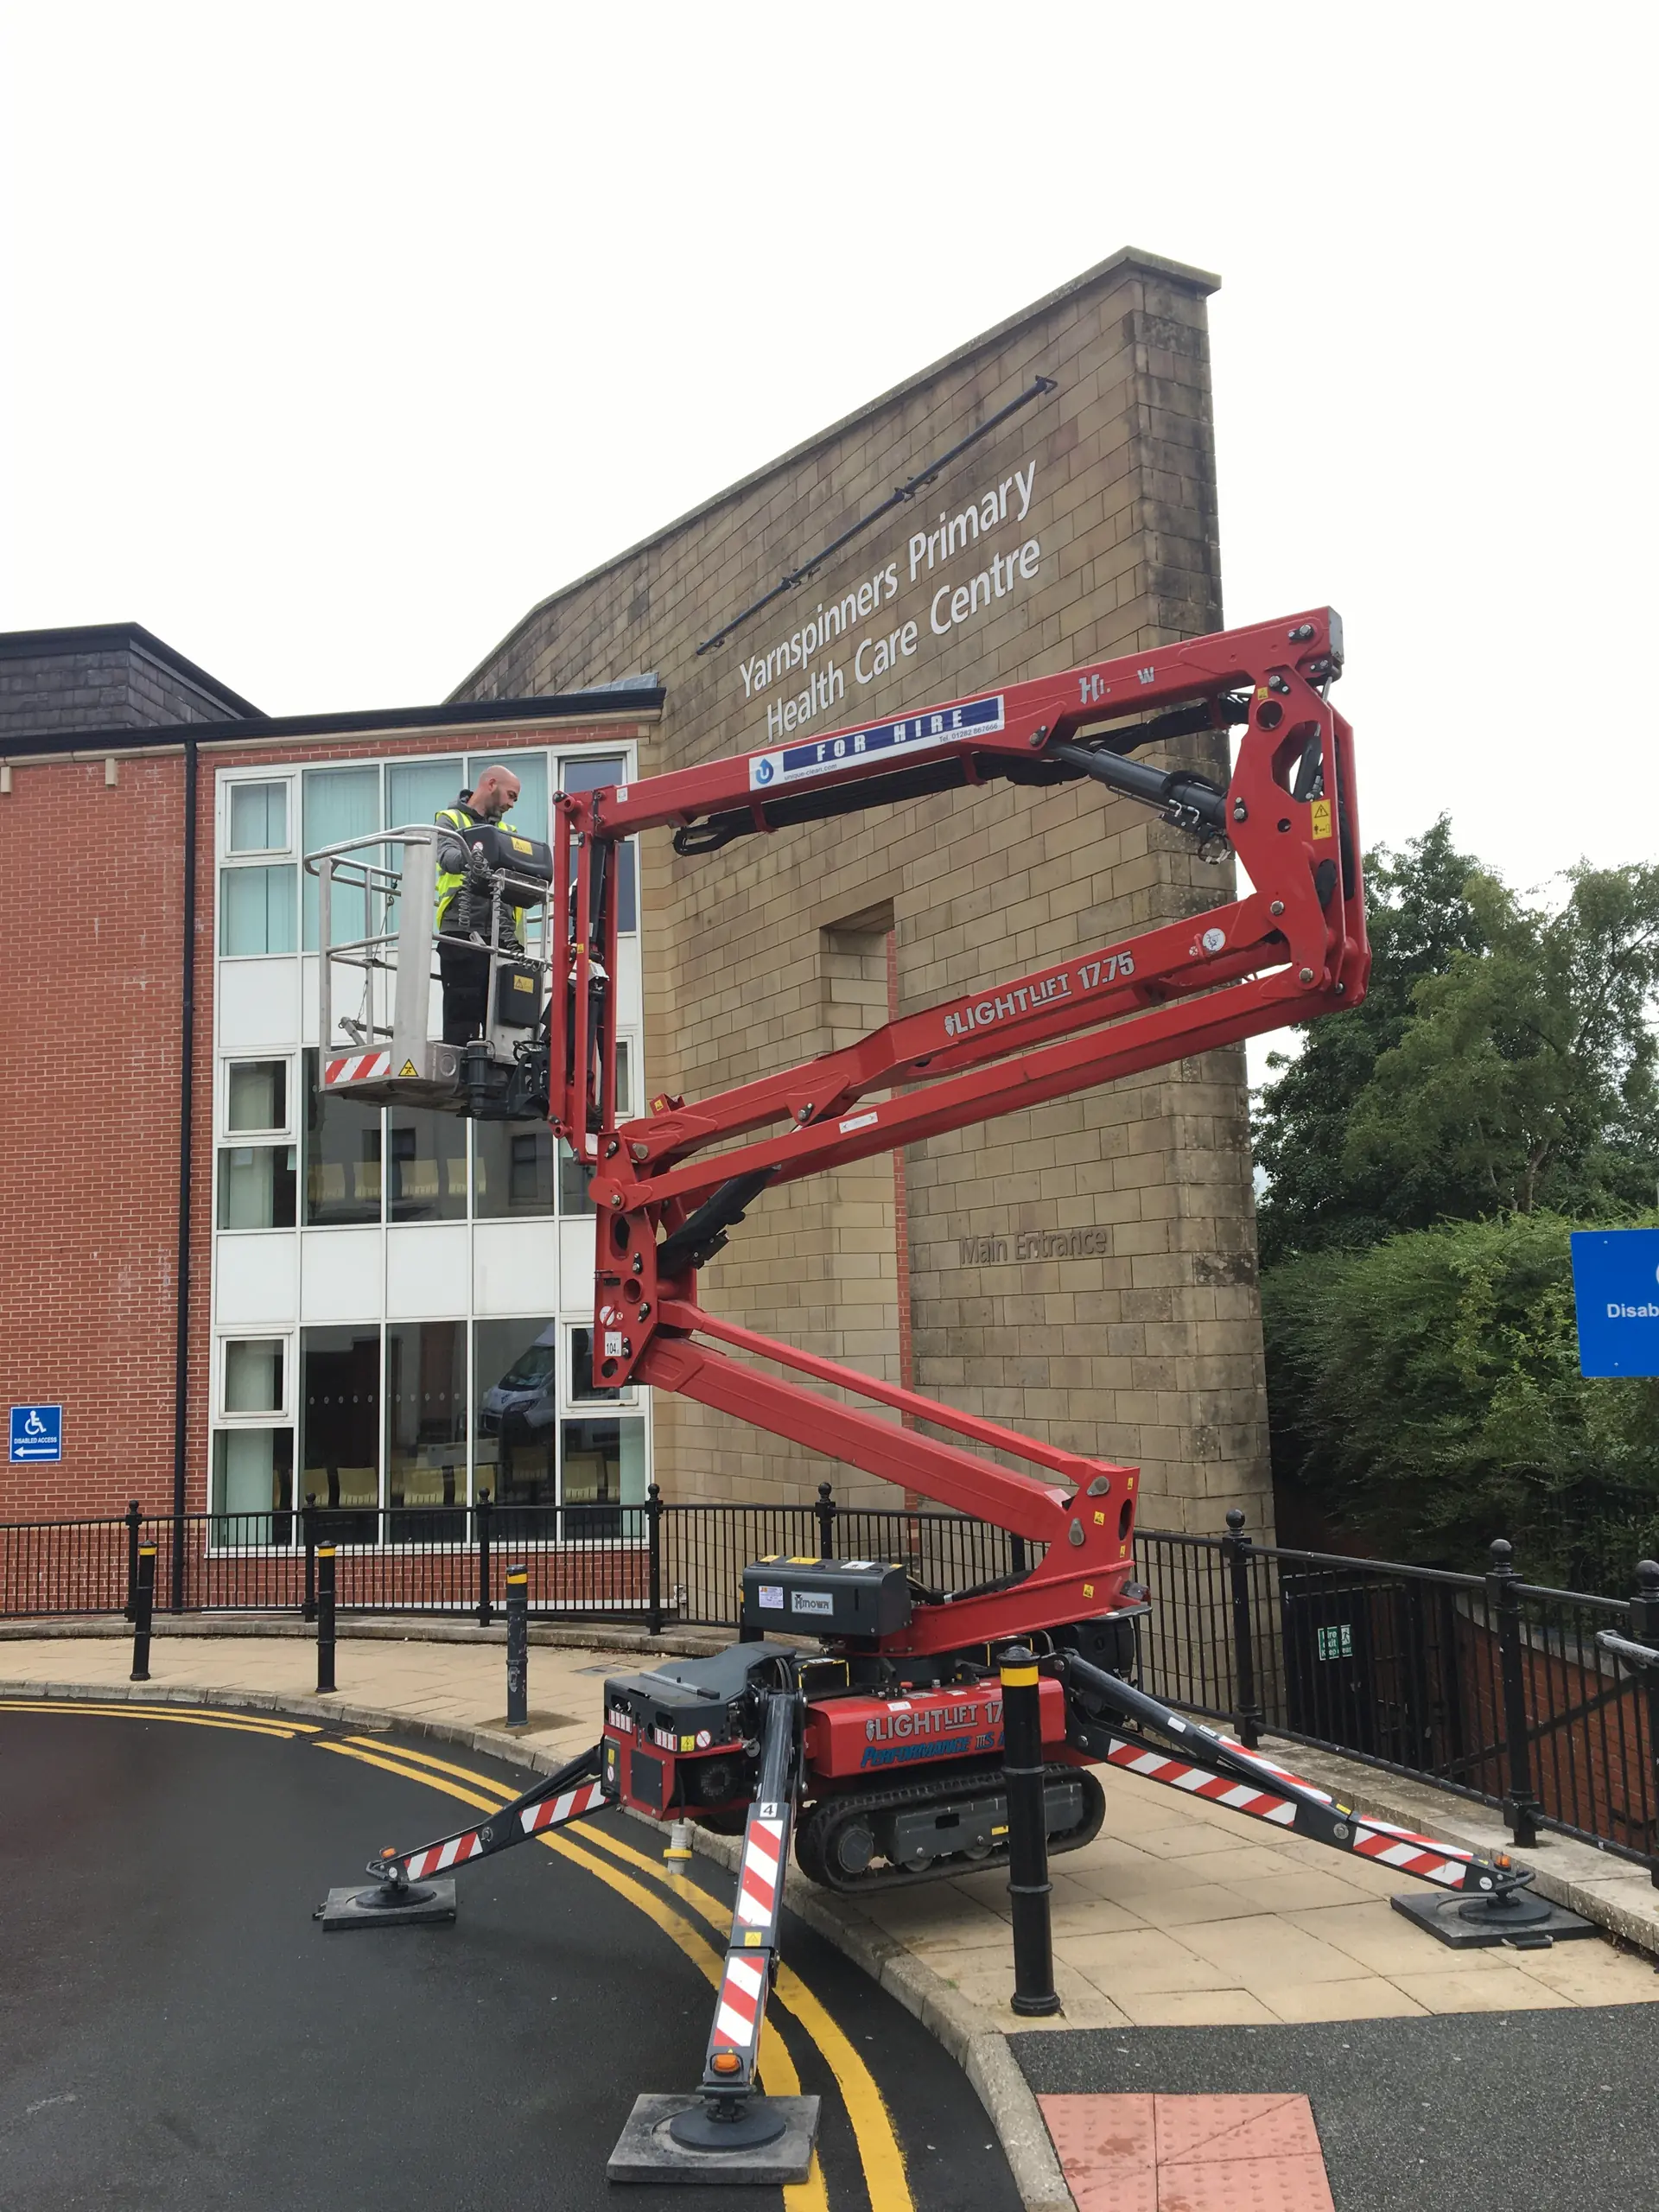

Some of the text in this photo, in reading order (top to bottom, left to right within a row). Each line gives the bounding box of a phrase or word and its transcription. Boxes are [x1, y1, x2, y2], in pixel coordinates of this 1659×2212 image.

[739, 460, 1036, 698] Yarnspinners Primary
[766, 539, 1040, 743] Health Care Centre
[817, 709, 963, 761] FOR HIRE
[952, 729, 972, 740] 01282
[785, 764, 837, 781] unique-clean.com
[1077, 950, 1135, 991] 17.75
[960, 1228, 1108, 1265] Main Entrance
[607, 1343, 616, 1354] 104
[763, 1804, 775, 1815] 4
